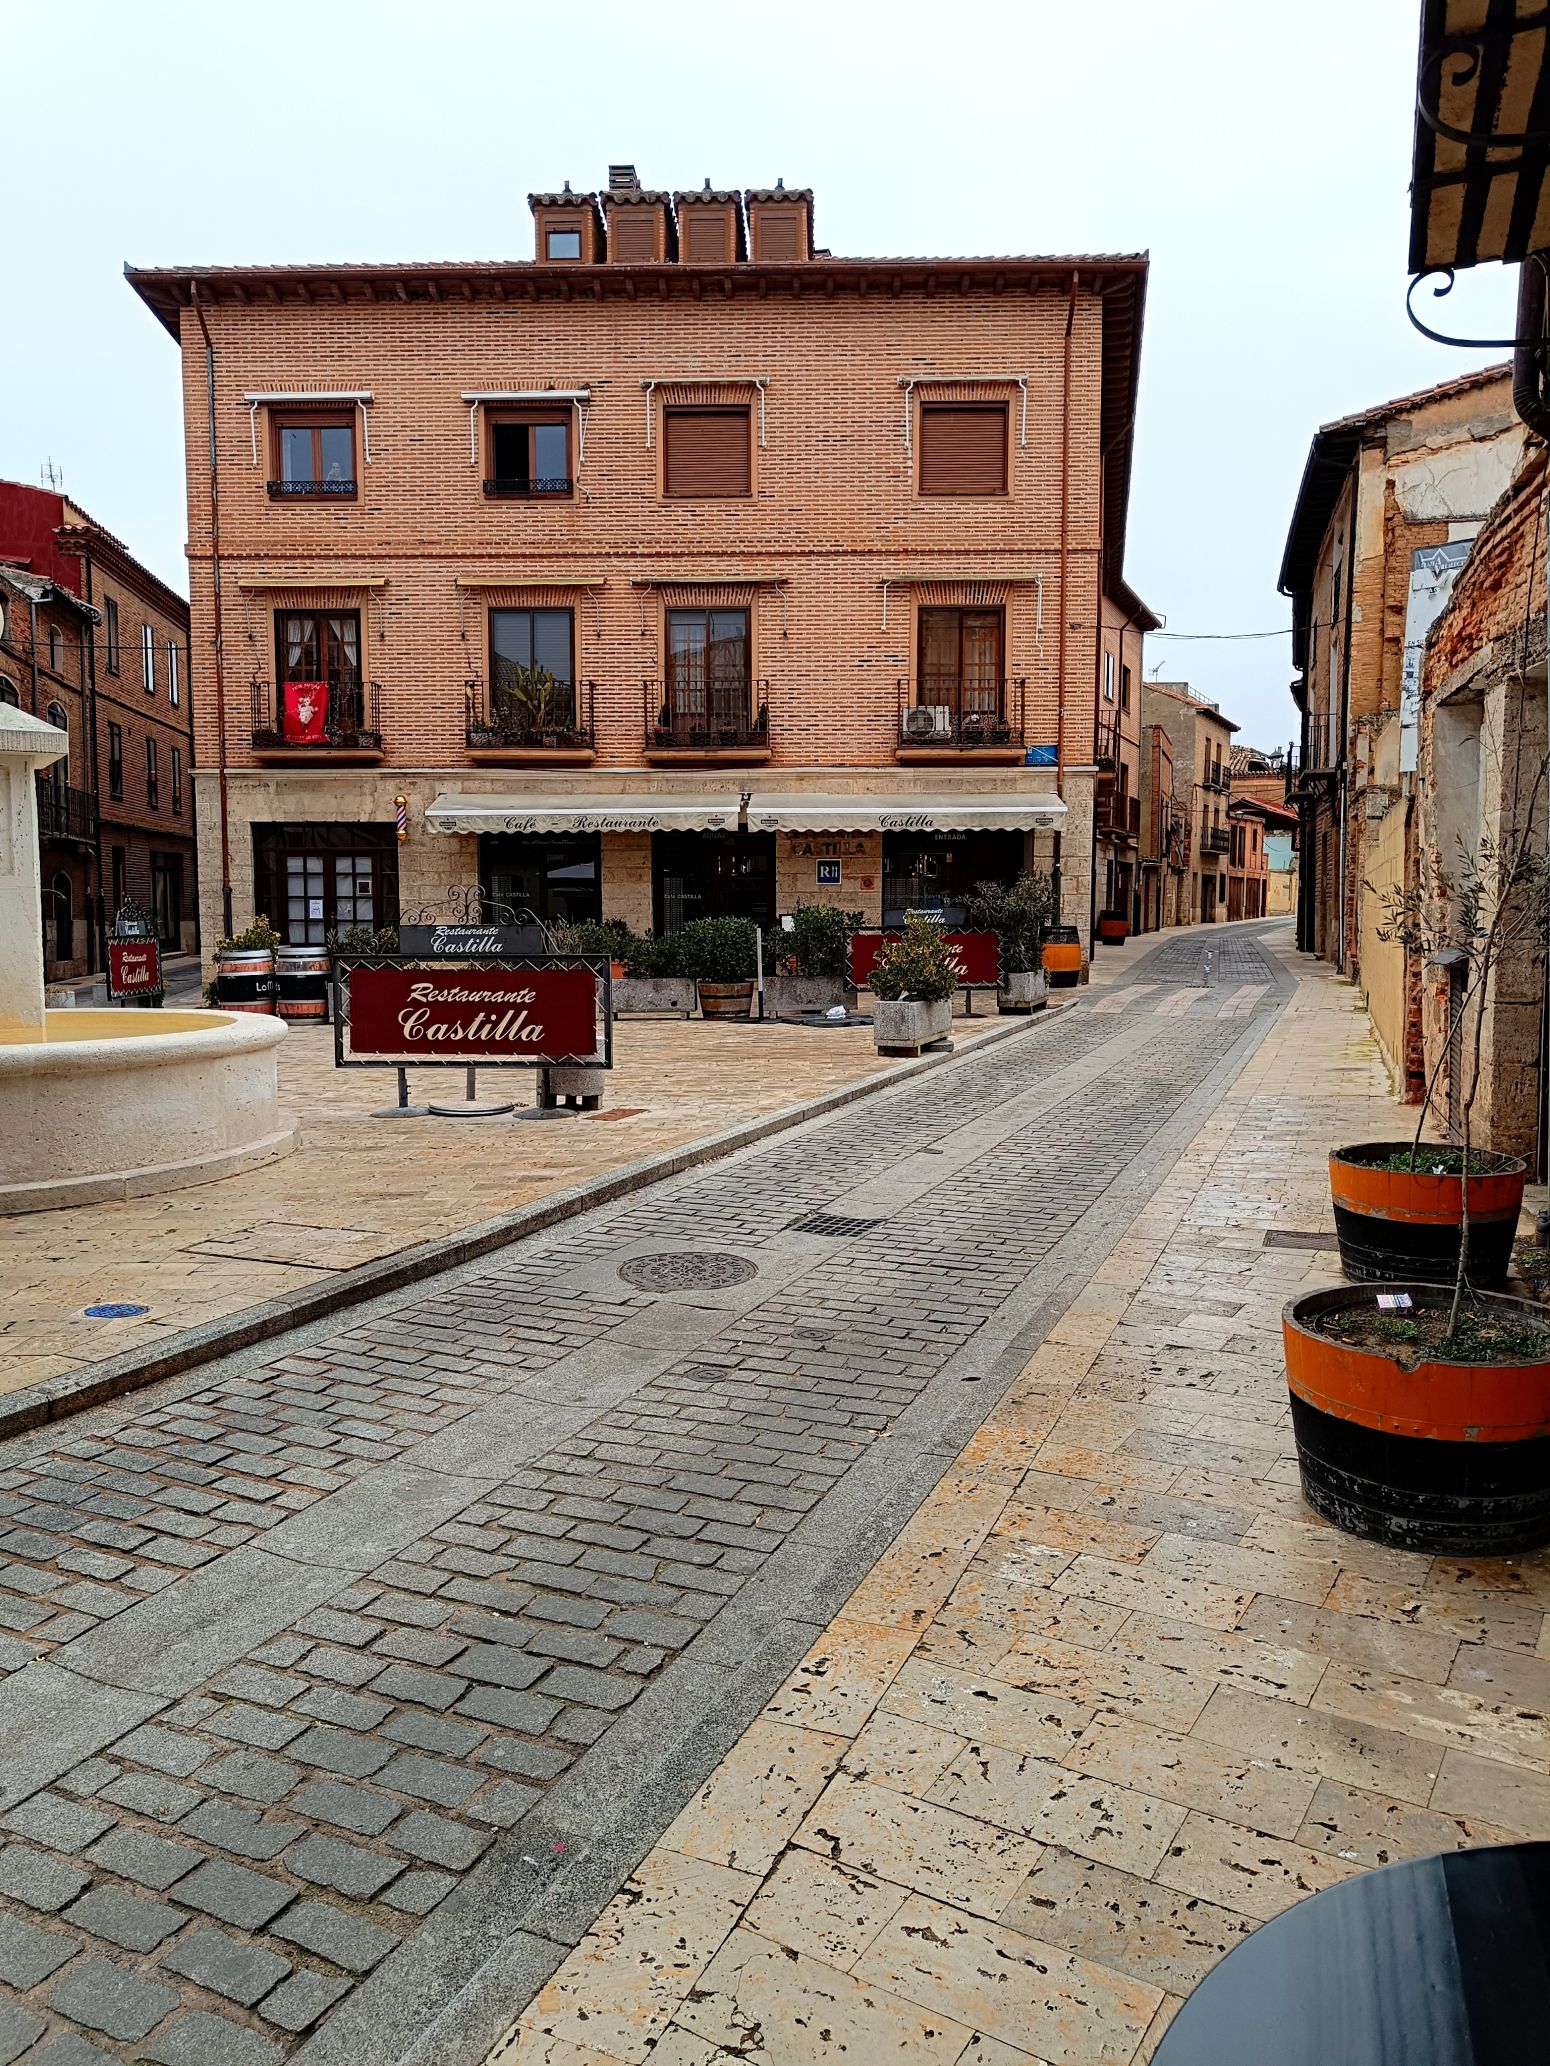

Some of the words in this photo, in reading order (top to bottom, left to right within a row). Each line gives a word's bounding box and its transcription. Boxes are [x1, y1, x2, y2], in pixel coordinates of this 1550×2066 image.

[504, 816, 537, 831] Café
[572, 815, 660, 829] Restaurante
[878, 814, 935, 828] Castilla
[934, 833, 966, 841] ENTRADA
[819, 865, 831, 878] R
[434, 925, 499, 936] Restaurante
[430, 936, 504, 953] Castilla
[120, 965, 150, 984] Castilla
[406, 982, 537, 1003] Restaurante
[397, 1007, 545, 1042] Castilla
